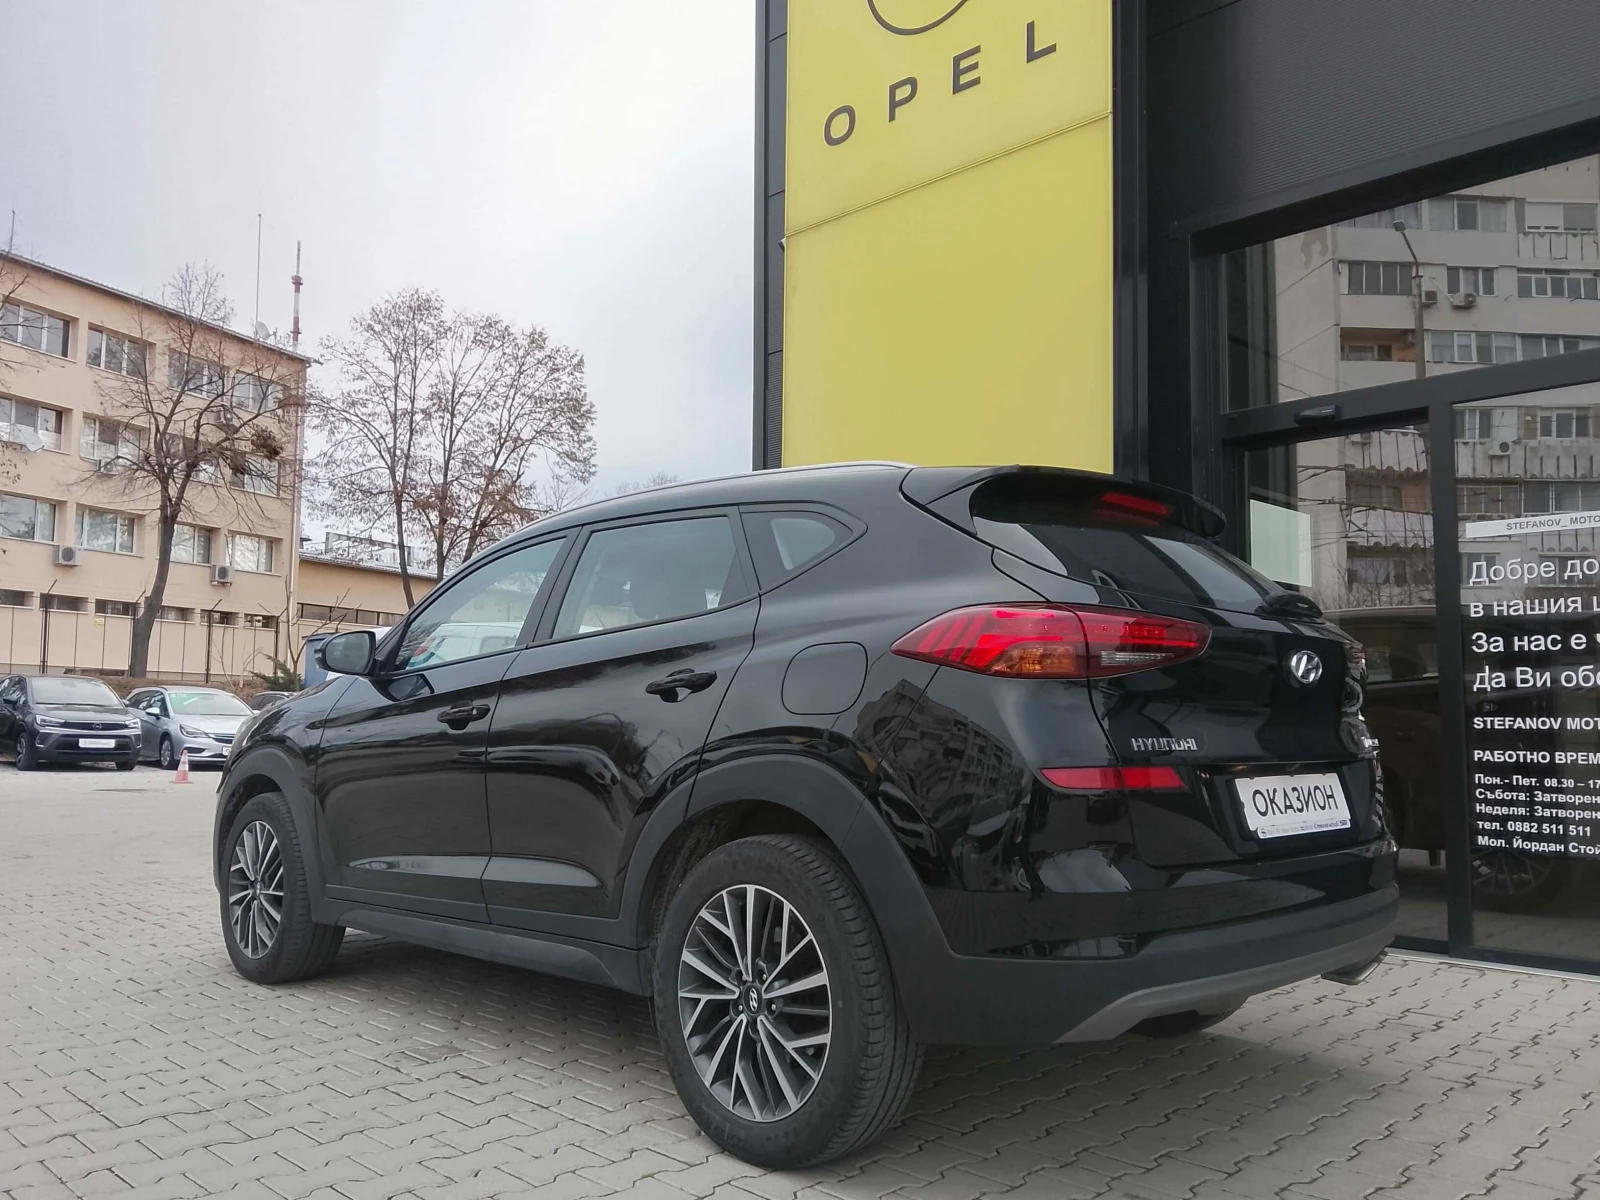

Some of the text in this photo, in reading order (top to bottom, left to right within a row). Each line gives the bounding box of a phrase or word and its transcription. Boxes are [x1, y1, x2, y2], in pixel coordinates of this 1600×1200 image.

[823, 19, 1057, 147] OPEL
[1469, 558, 1556, 586] Добре
[1470, 602, 1484, 617] в
[1493, 597, 1582, 616] нашия
[1471, 632, 1505, 653] За
[1513, 633, 1562, 651] нас
[1570, 633, 1587, 650] е
[1473, 665, 1506, 691] да
[1516, 667, 1551, 687] Ви
[1473, 717, 1562, 730] STEFANOV
[1131, 738, 1198, 751] HYUNDAI
[1473, 750, 1600, 764] РАБОТНО ВРЕМ
[1512, 775, 1540, 786] Пет.
[1544, 778, 1575, 788] 08.30
[1252, 784, 1339, 817] ОКАЗИОН
[1475, 789, 1530, 801] Събота:
[1475, 803, 1530, 816] Неделя:
[1477, 821, 1591, 837] тел. 0882 511 511
[1512, 836, 1565, 853] Йордан
